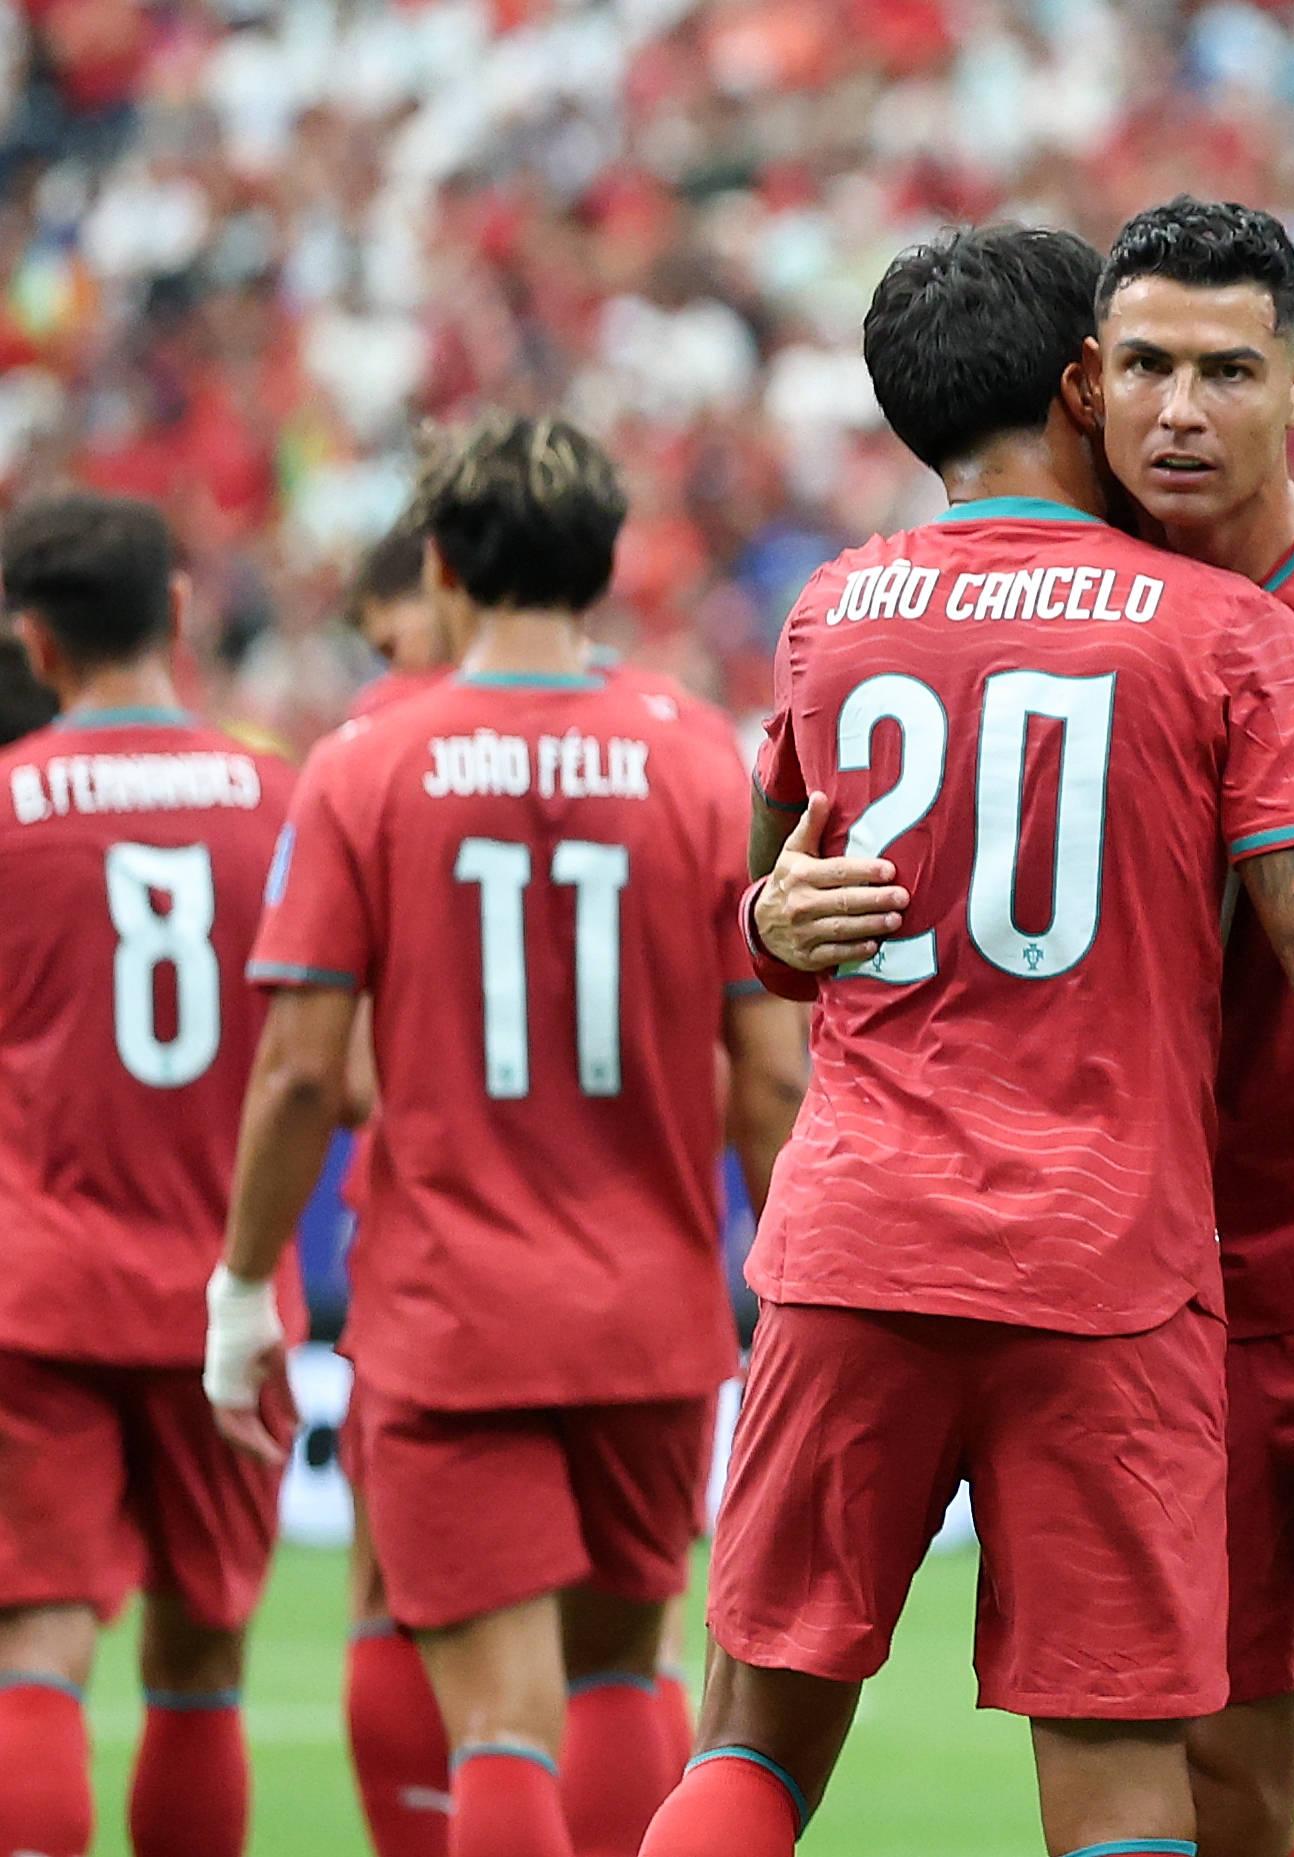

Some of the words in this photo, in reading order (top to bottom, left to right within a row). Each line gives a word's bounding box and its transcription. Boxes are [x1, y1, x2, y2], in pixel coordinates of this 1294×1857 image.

[825, 558, 941, 626] JOÃO
[945, 566, 1164, 623] CANCELO
[422, 727, 531, 798] JOÃO
[537, 726, 649, 800] FÉLIX
[834, 668, 1117, 985] 20
[106, 842, 221, 1089] 8
[454, 837, 629, 1099] 11
